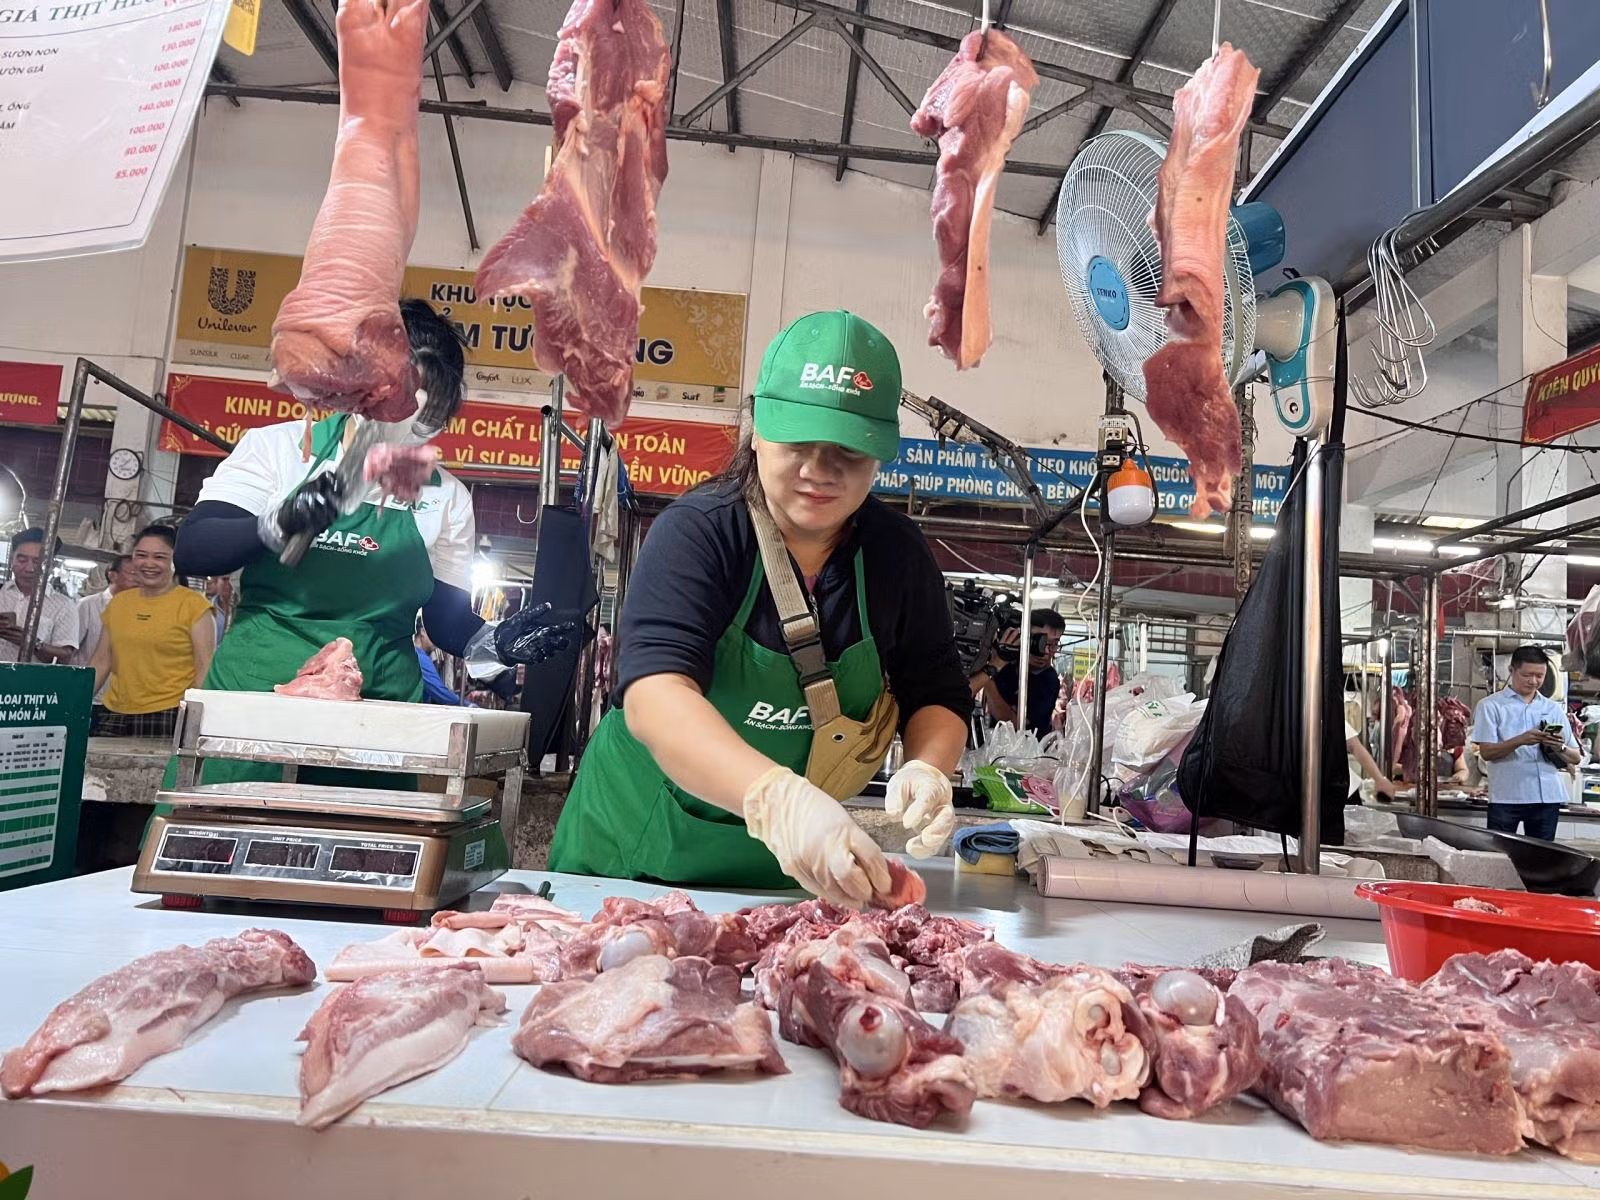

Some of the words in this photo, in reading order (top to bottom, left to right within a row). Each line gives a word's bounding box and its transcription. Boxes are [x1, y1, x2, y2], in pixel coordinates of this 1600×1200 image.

[0, 8, 38, 23] GIÁ
[50, 2, 102, 21] THỊT
[0, 65, 25, 75] ƯỜN
[431, 283, 477, 304] KHU
[1096, 287, 1117, 299] SENKO
[197, 316, 257, 333] Unilever
[800, 362, 855, 384] BAF
[476, 371, 500, 383] Comfort
[511, 375, 533, 386] LUX
[682, 391, 701, 401] Surf
[0, 392, 42, 406] ƯỢNG.
[225, 396, 271, 417] KINH
[471, 415, 525, 441] CHẤT
[634, 431, 686, 455] TOÀN
[455, 443, 474, 463] VÌ
[906, 443, 934, 465] SẢN
[937, 444, 977, 468] PHẨM
[1037, 456, 1066, 474] HEO
[1255, 471, 1286, 493] MỘT
[872, 468, 908, 488] PHÁP
[912, 471, 944, 492] GIÚP
[947, 474, 993, 496] PHÒNG
[24, 694, 45, 708] THỊT
[46, 692, 59, 705] VÀ
[8, 707, 31, 721] MÓN
[32, 707, 47, 721] ĂN
[748, 701, 809, 724] BAF
